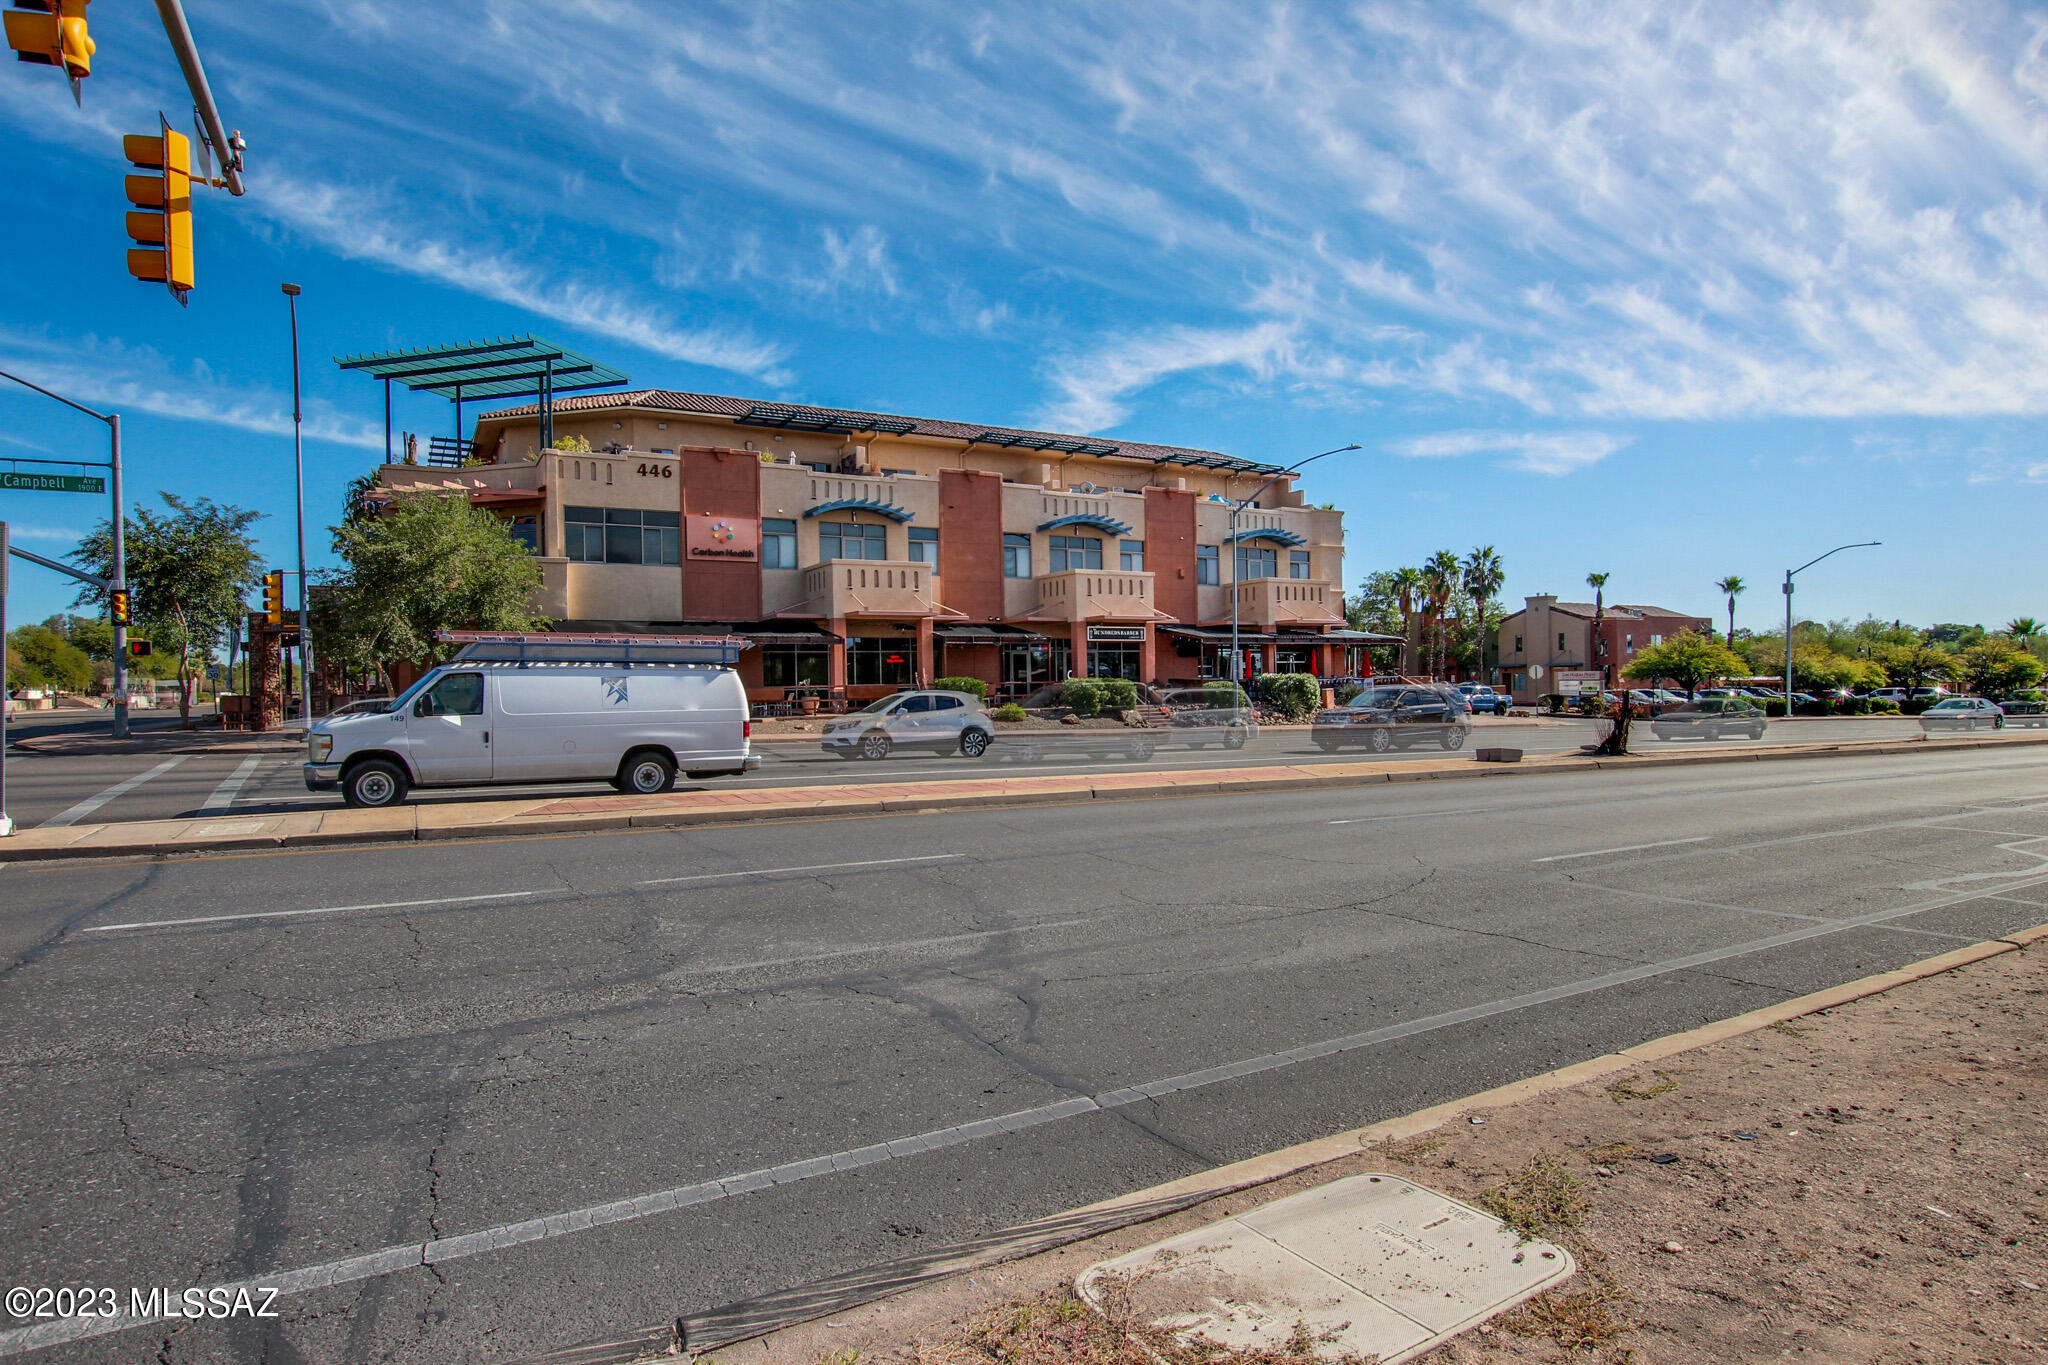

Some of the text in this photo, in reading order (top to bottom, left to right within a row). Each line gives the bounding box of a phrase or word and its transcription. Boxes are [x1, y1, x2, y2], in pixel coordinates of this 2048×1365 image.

[637, 463, 673, 478] 446
[4, 474, 65, 490] Campbell
[692, 547, 755, 557] Carbon Health
[390, 714, 405, 722] 149
